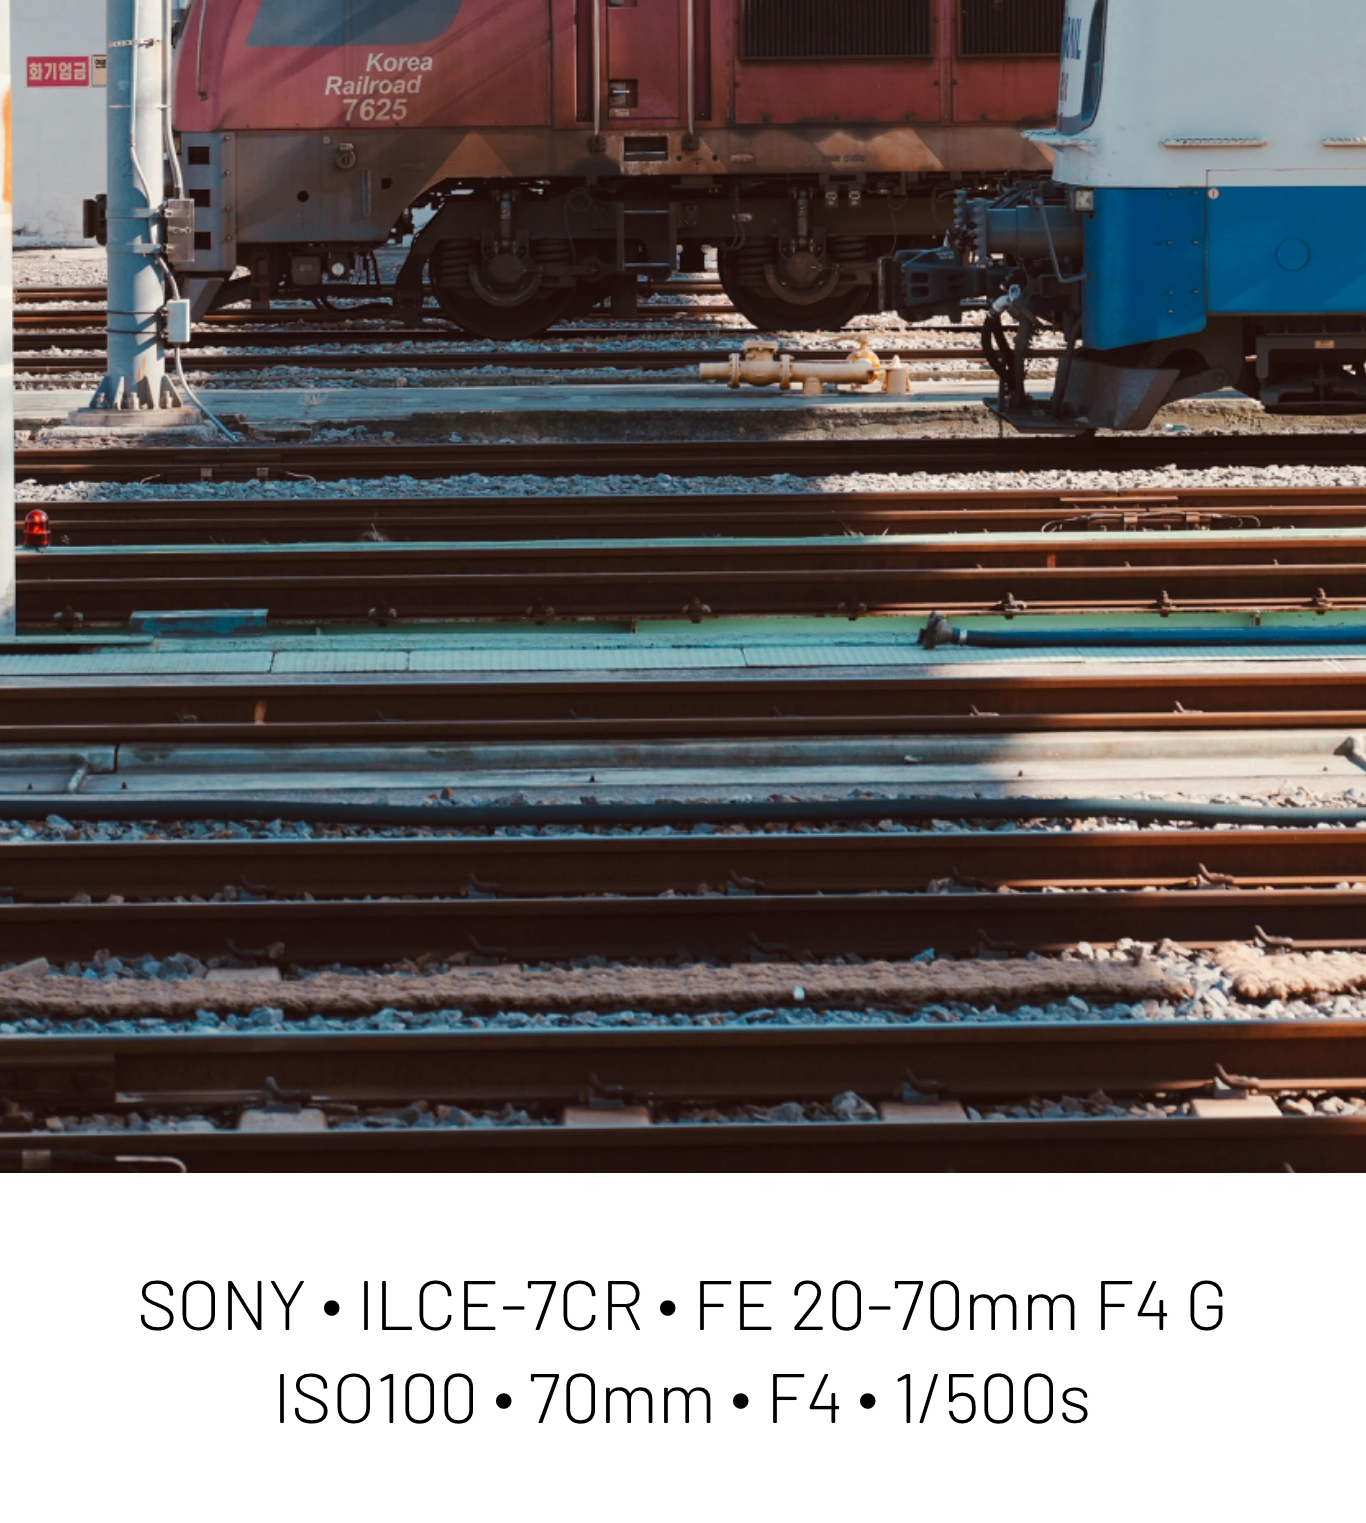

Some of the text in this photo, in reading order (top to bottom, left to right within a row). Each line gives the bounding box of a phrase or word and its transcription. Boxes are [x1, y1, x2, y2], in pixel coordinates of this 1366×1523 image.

[28, 61, 87, 82] 화기엄금
[366, 52, 433, 72] Korea
[324, 74, 423, 96] Railroad
[342, 98, 408, 122] 7625
